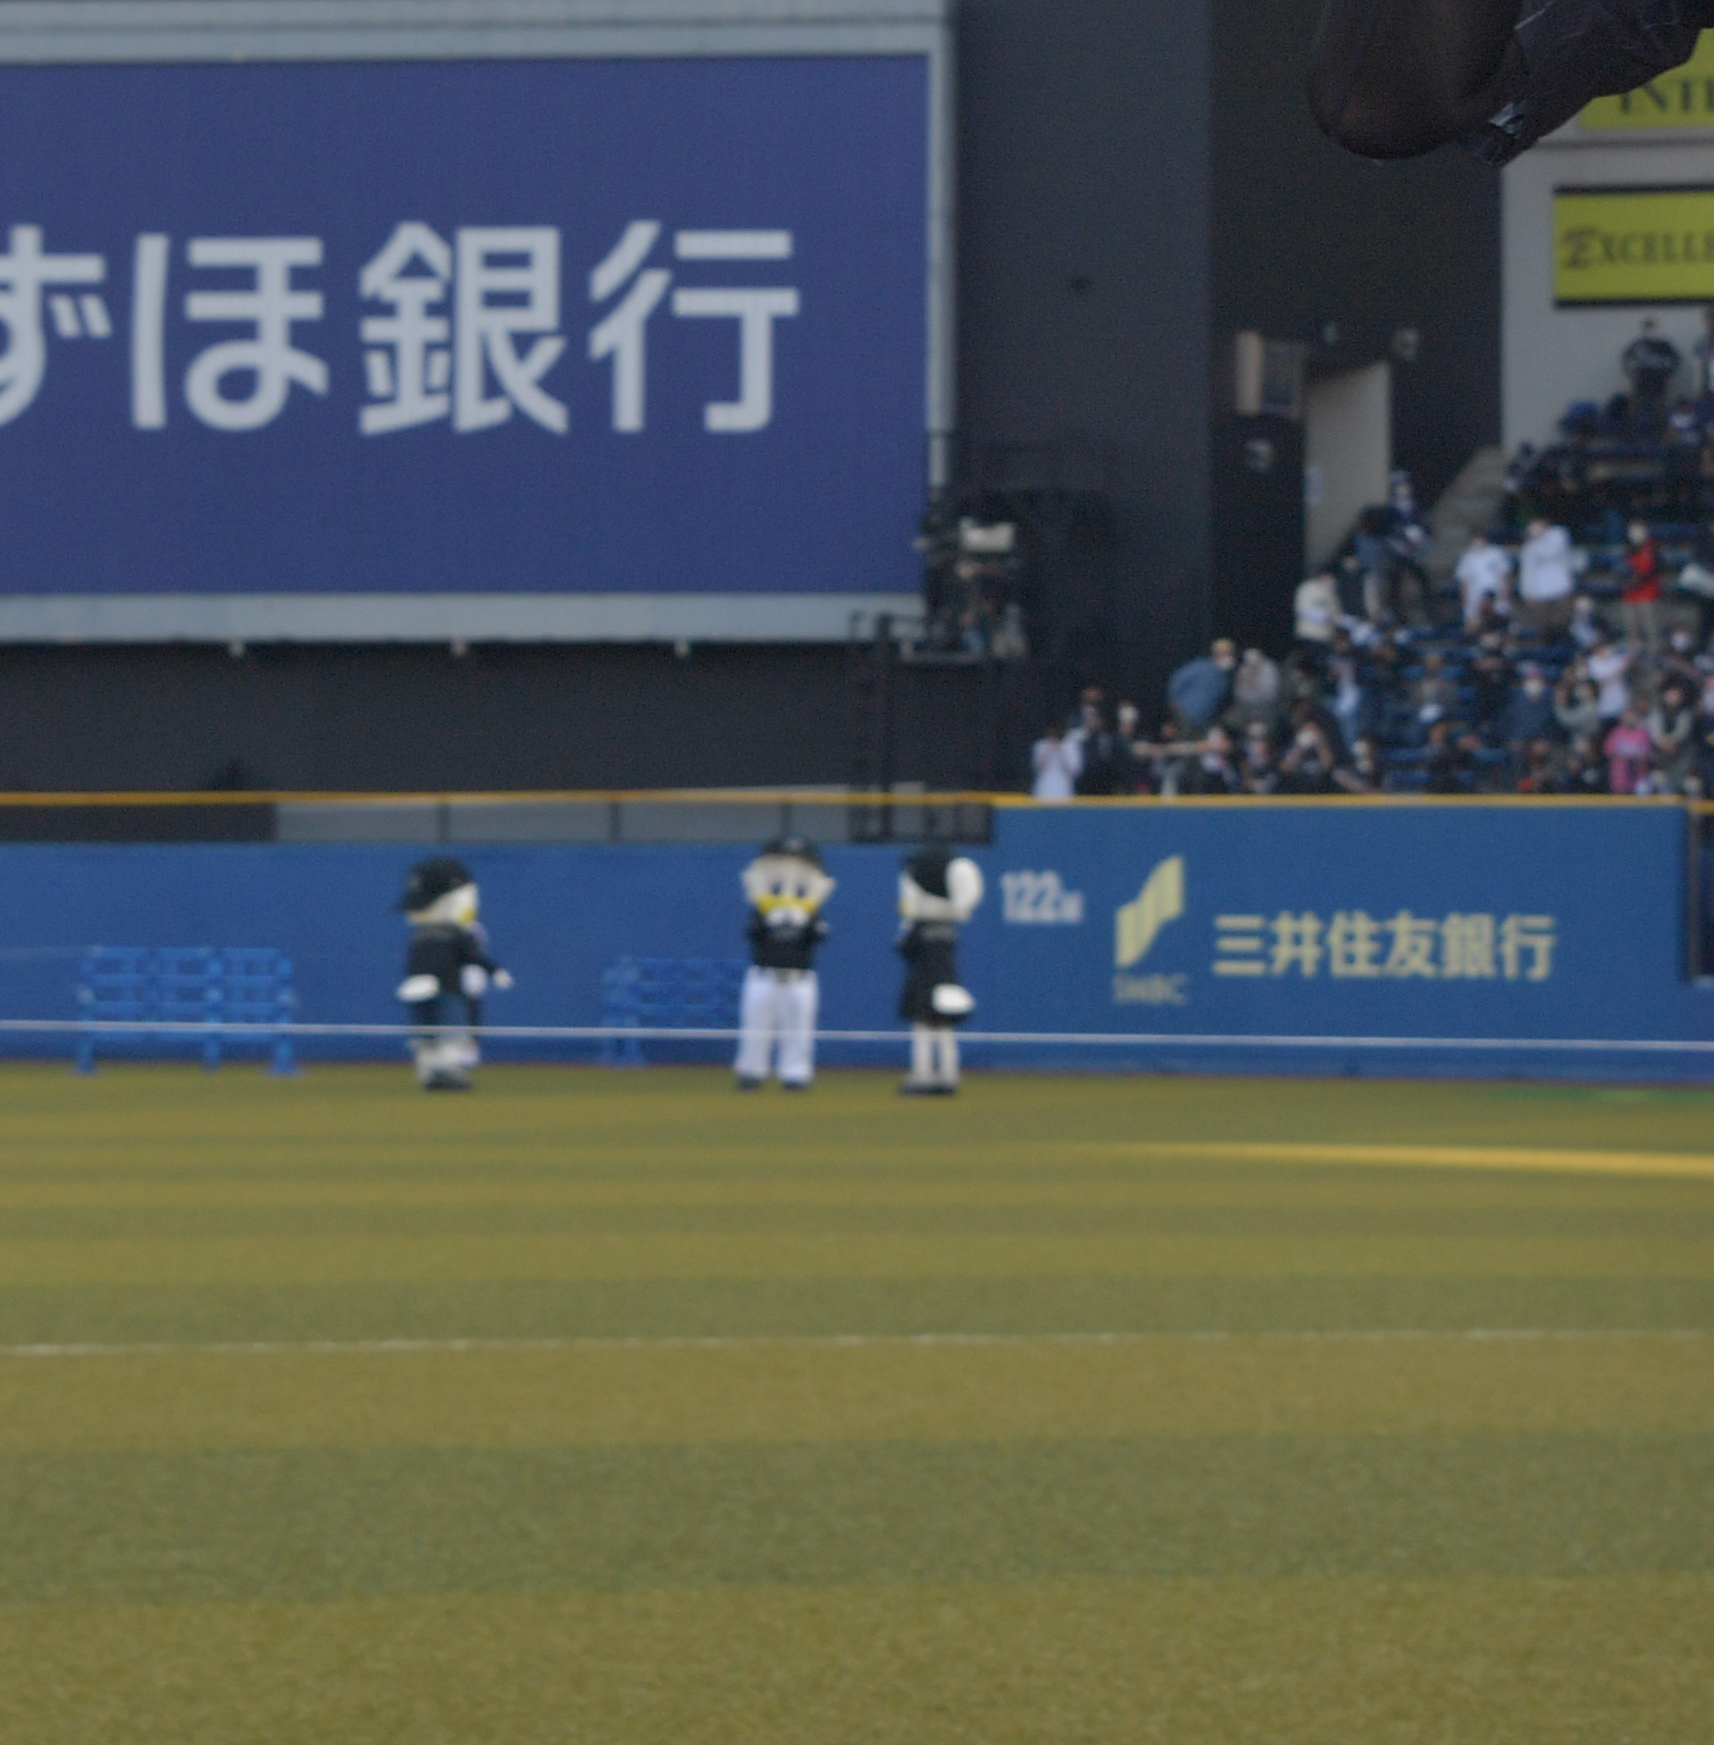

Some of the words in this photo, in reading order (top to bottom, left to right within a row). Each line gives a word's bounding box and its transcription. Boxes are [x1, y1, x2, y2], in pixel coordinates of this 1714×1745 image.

[1211, 909, 1556, 982] 三井住友銀行
